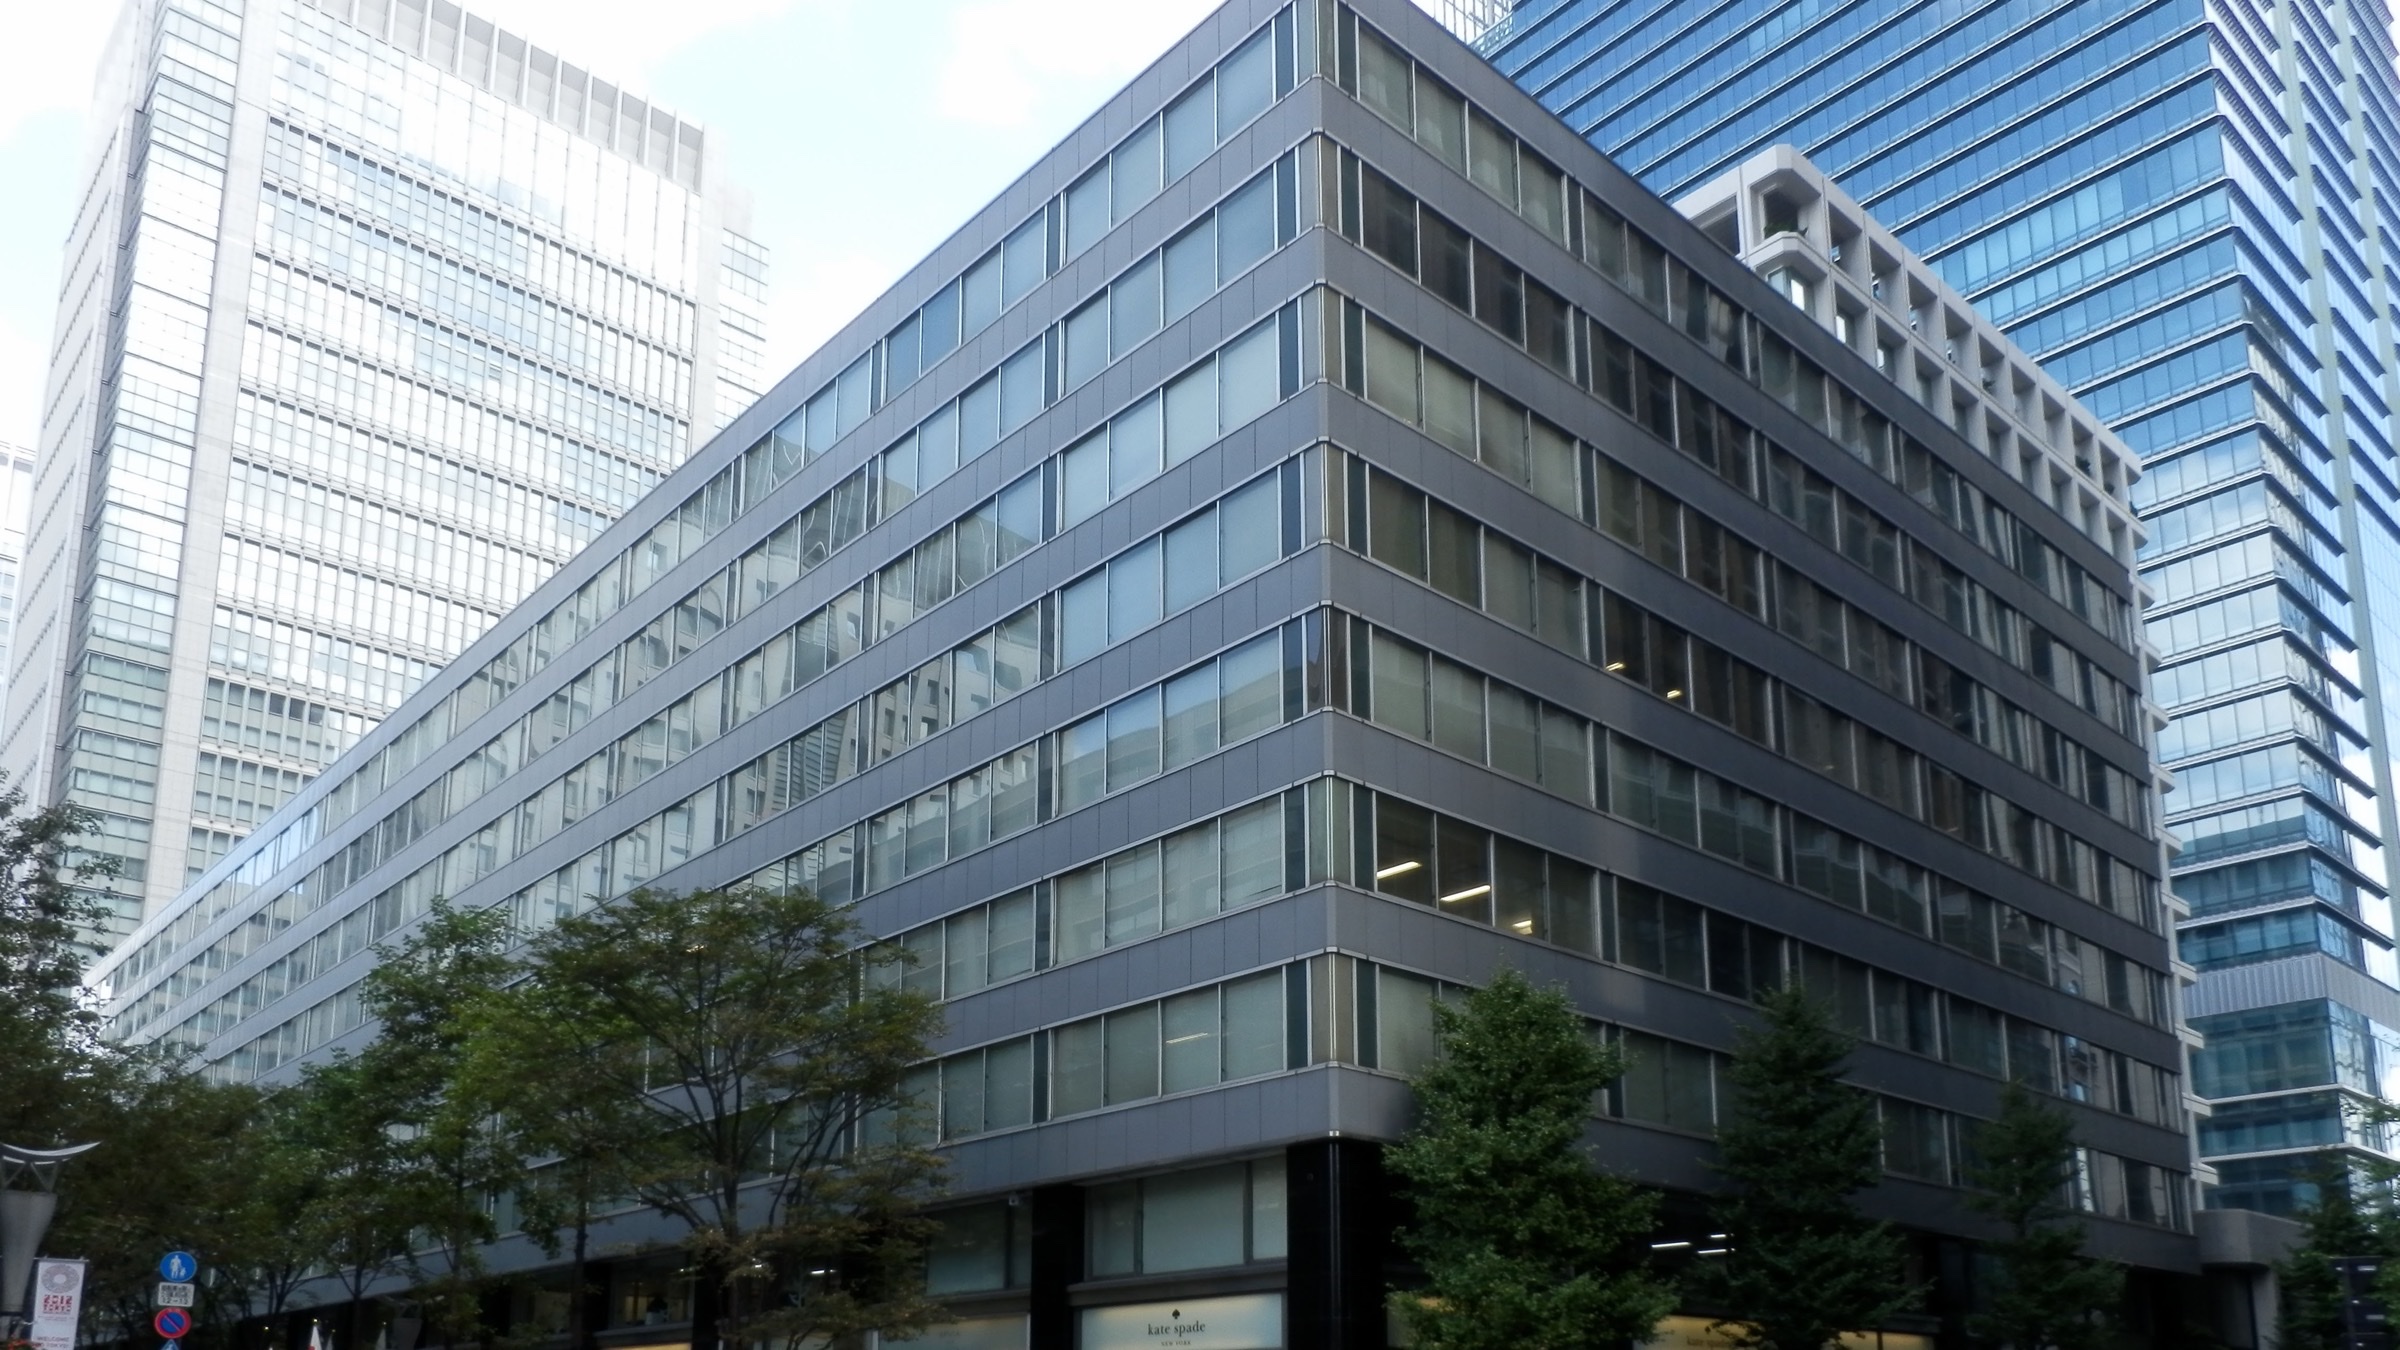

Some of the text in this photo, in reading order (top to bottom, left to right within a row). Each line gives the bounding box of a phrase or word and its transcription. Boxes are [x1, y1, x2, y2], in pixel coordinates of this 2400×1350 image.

[43, 1295, 72, 1305] 2012
[1148, 1320, 1206, 1337] kate spade
